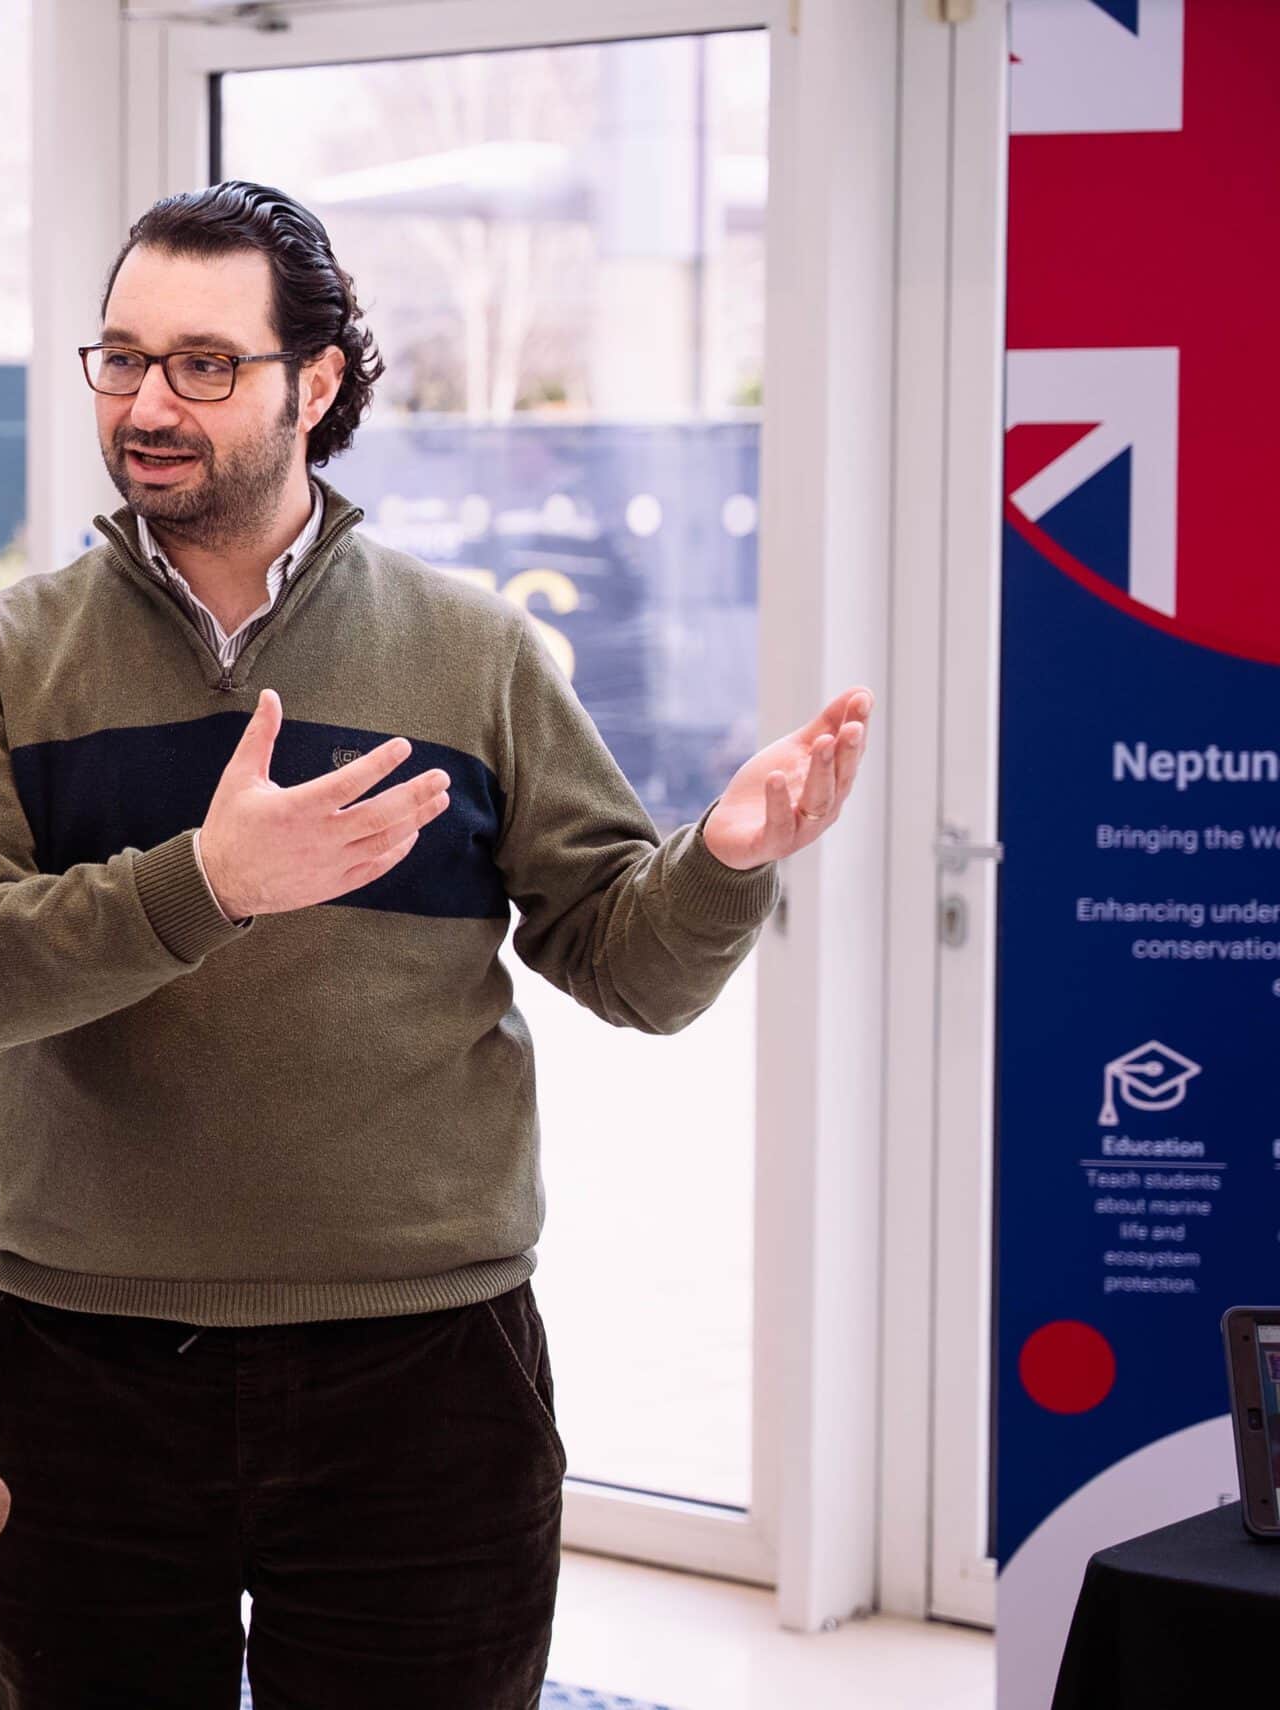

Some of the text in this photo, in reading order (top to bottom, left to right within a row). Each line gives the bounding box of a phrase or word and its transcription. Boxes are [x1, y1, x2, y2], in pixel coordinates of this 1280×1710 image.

[1112, 741, 1280, 791] Neptun
[1096, 824, 1280, 854] Bringing the W
[1076, 897, 1205, 928] Enhancing
[1131, 936, 1280, 960] conservatio
[1101, 1136, 1205, 1157] Education
[1086, 1169, 1221, 1190] Teach students
[1094, 1197, 1212, 1216] about marine
[1119, 1222, 1186, 1242] life and
[1103, 1250, 1200, 1270] ecosystem
